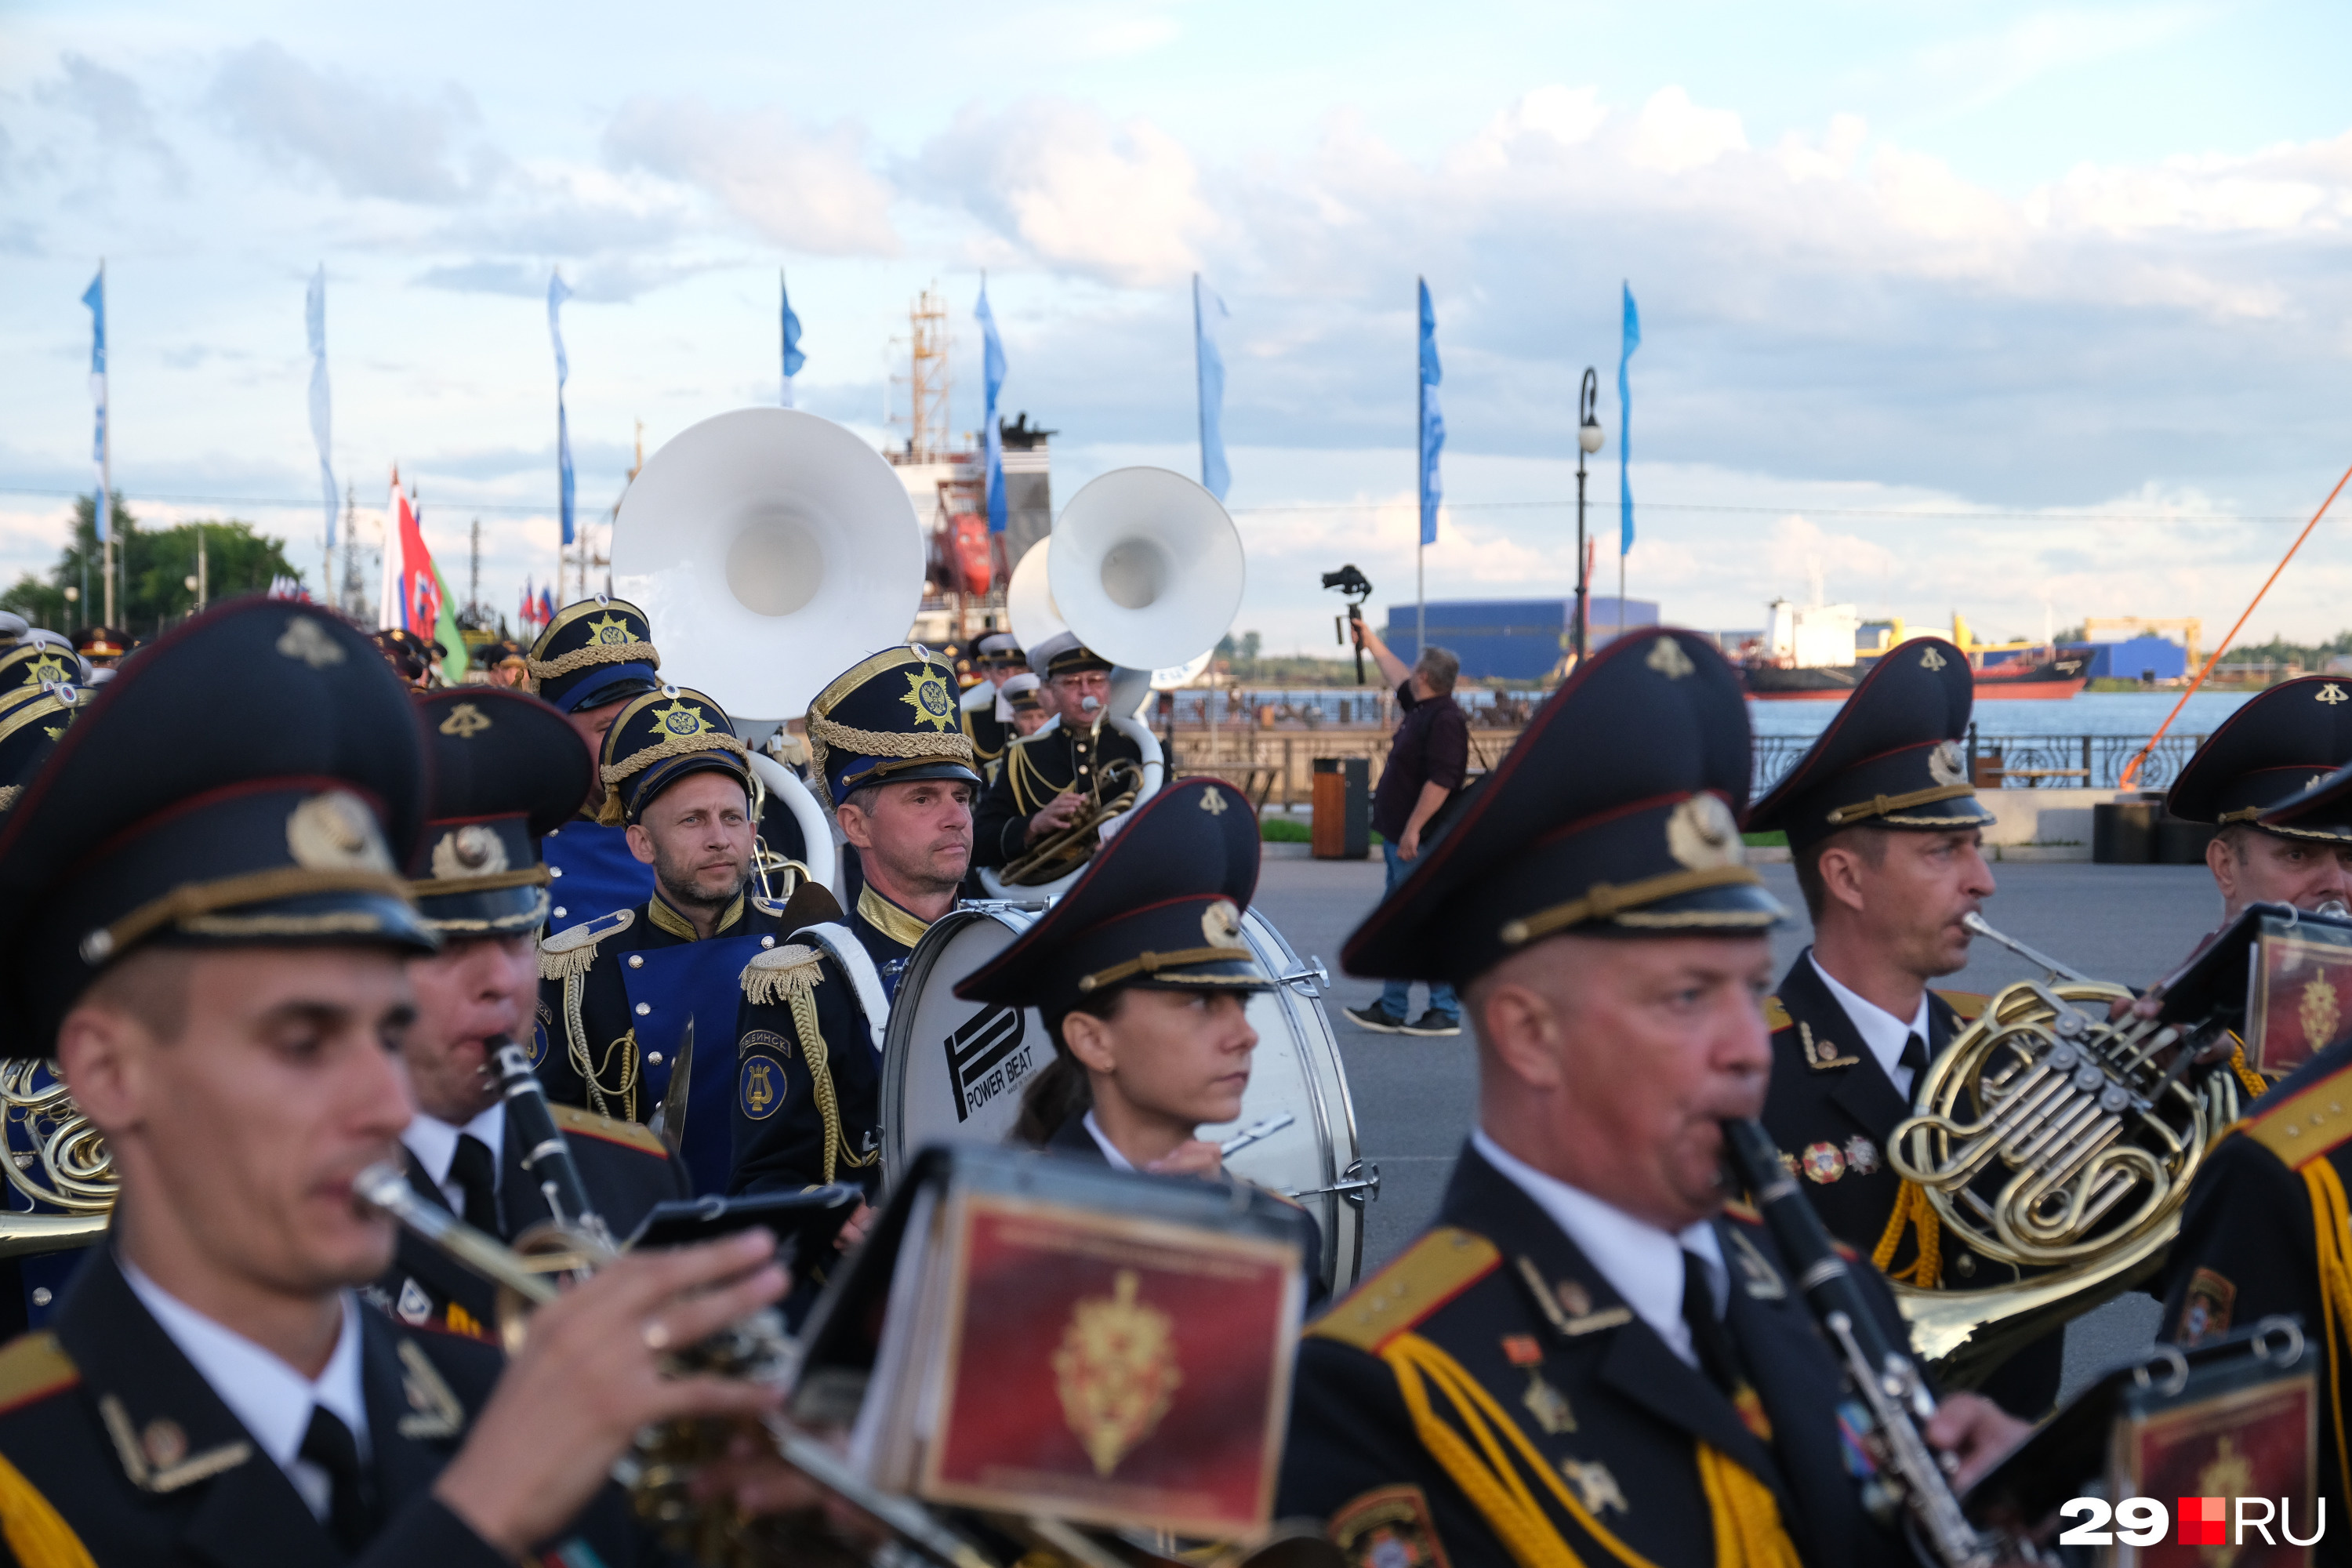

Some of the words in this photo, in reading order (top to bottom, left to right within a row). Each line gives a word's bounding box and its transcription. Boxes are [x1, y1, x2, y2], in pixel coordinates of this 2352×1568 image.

[741, 1033, 786, 1050] РЫБИНСК
[966, 1069, 1006, 1113] POWER
[1004, 1045, 1033, 1083] BEAT
